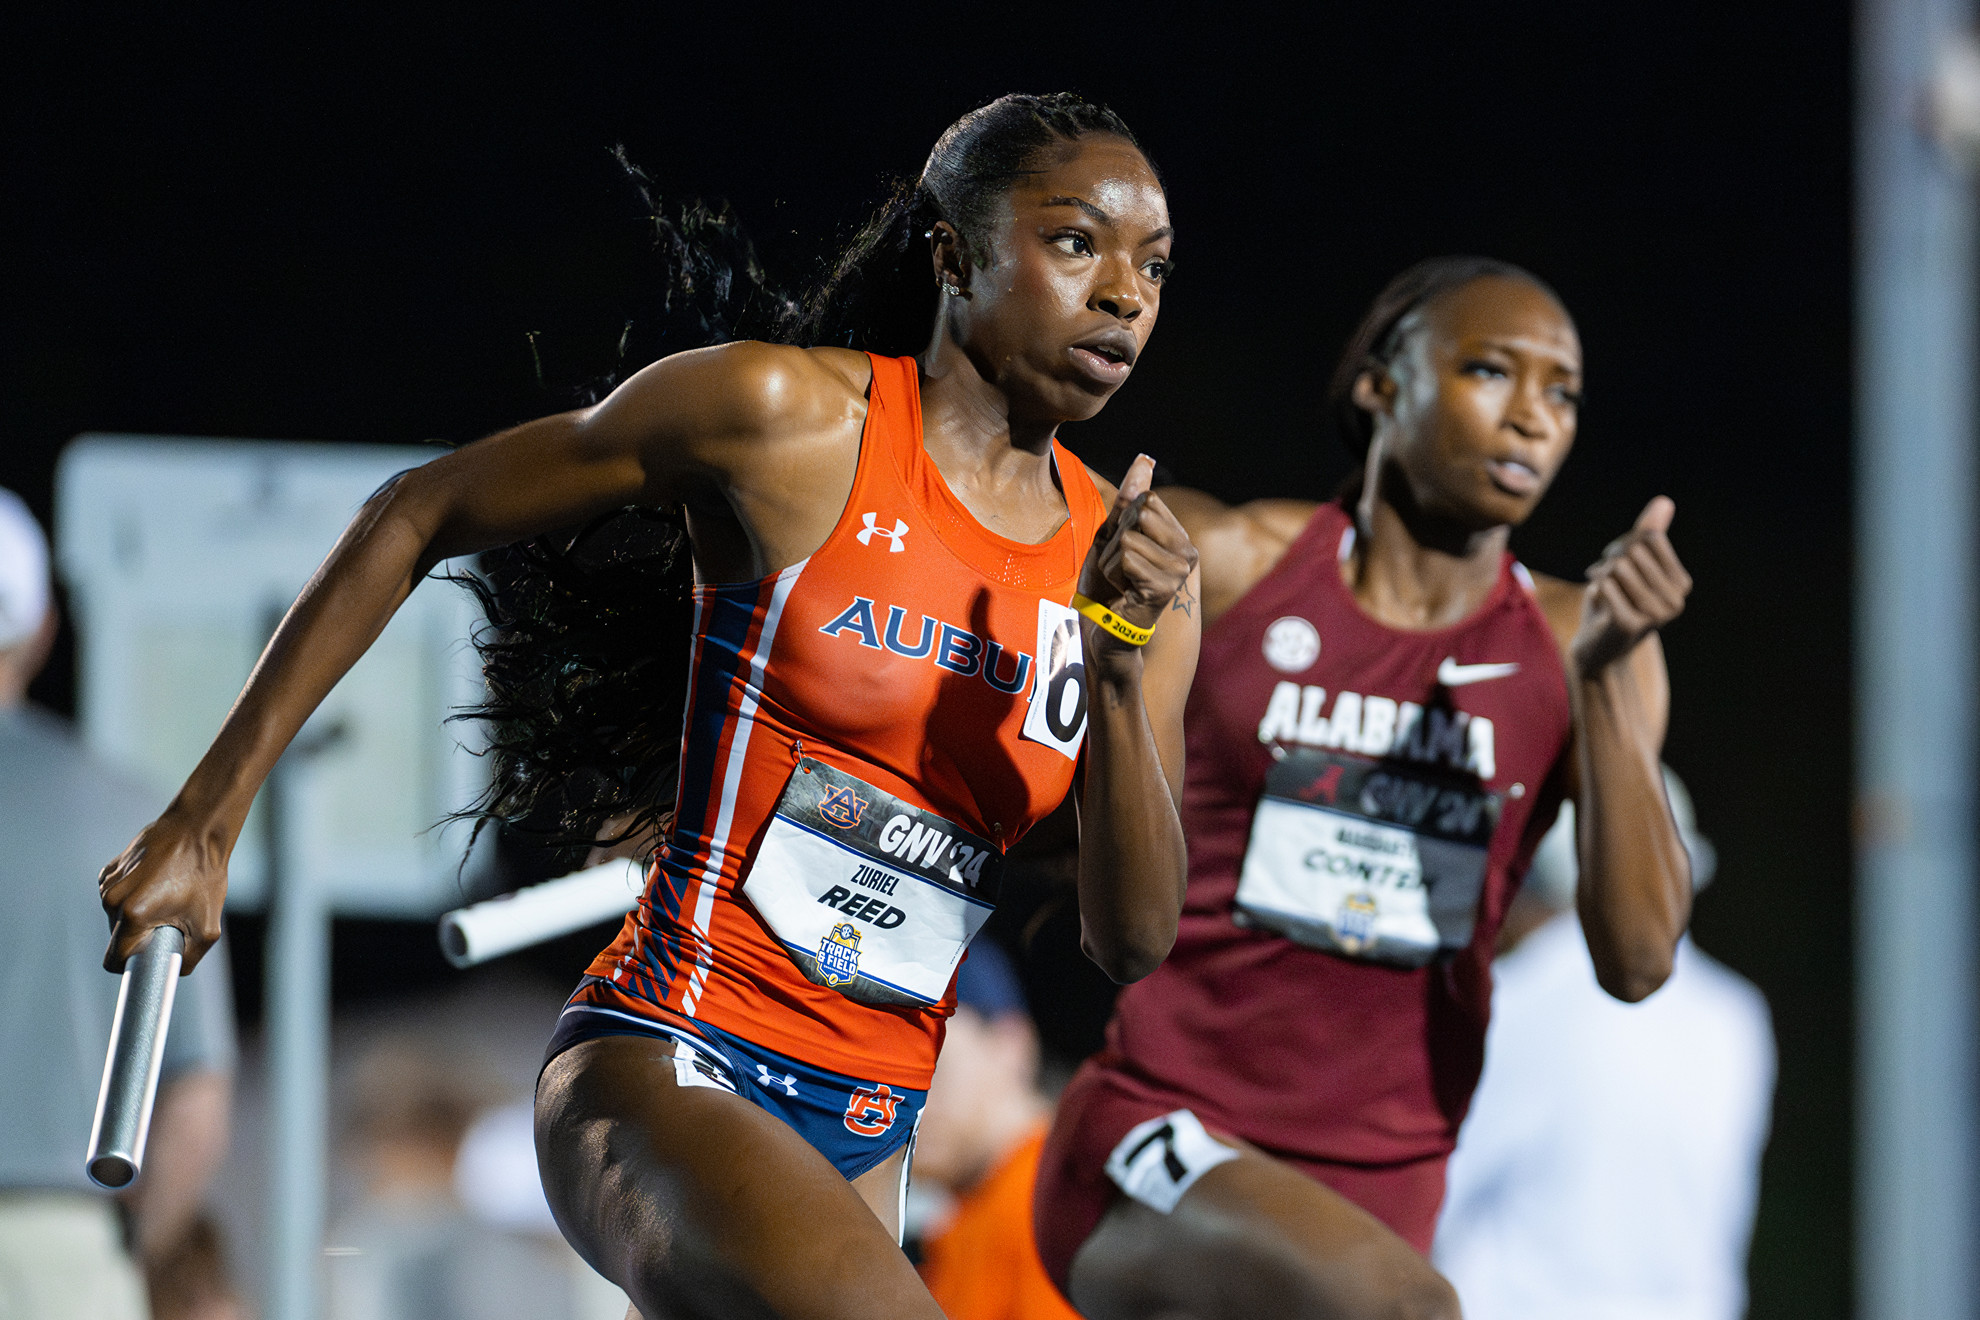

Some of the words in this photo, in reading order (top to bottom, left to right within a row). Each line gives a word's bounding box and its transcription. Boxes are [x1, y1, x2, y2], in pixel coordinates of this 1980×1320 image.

[819, 595, 1037, 703] AUBU
[1045, 618, 1087, 742] 6
[1263, 680, 1497, 780] ALABAMA
[879, 814, 952, 869] GNV
[817, 884, 906, 930] REED
[851, 864, 900, 897] ZURIEL
[817, 950, 826, 963] &
[827, 954, 857, 975] FIELD
[821, 938, 860, 964] TRACK
[1125, 1122, 1188, 1183] 7
